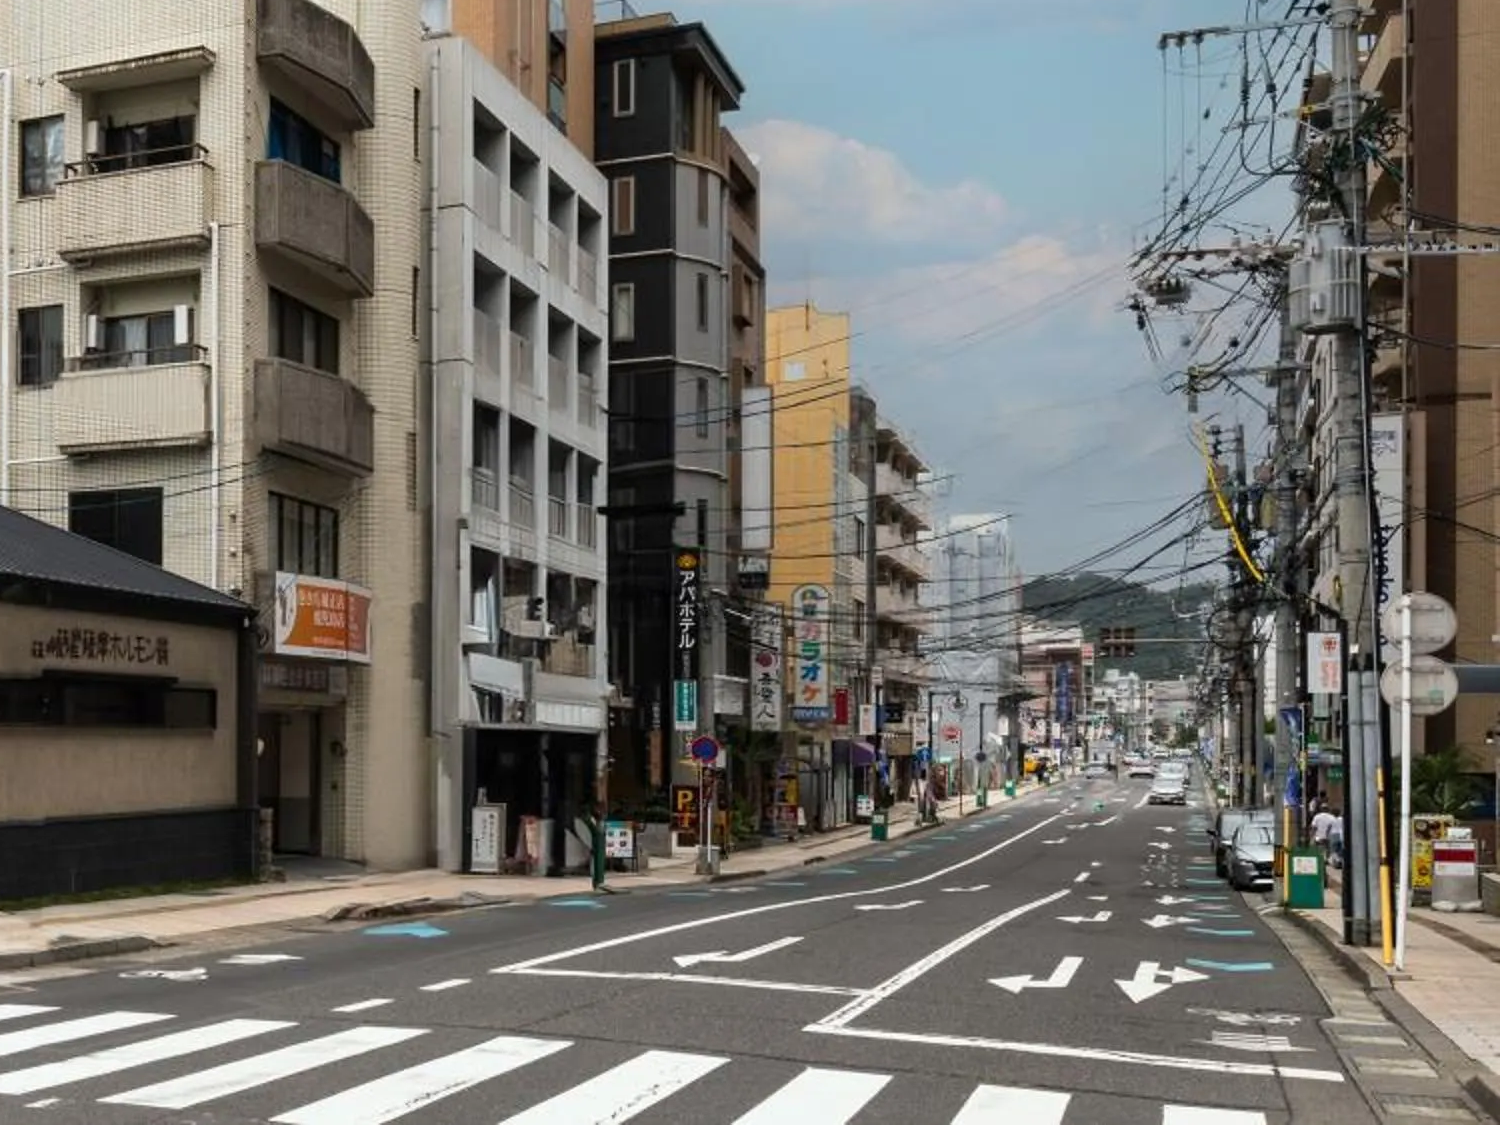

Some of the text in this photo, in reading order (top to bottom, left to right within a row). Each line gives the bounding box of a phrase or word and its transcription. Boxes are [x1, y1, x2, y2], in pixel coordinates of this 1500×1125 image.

[679, 570, 696, 649] アパホテル
